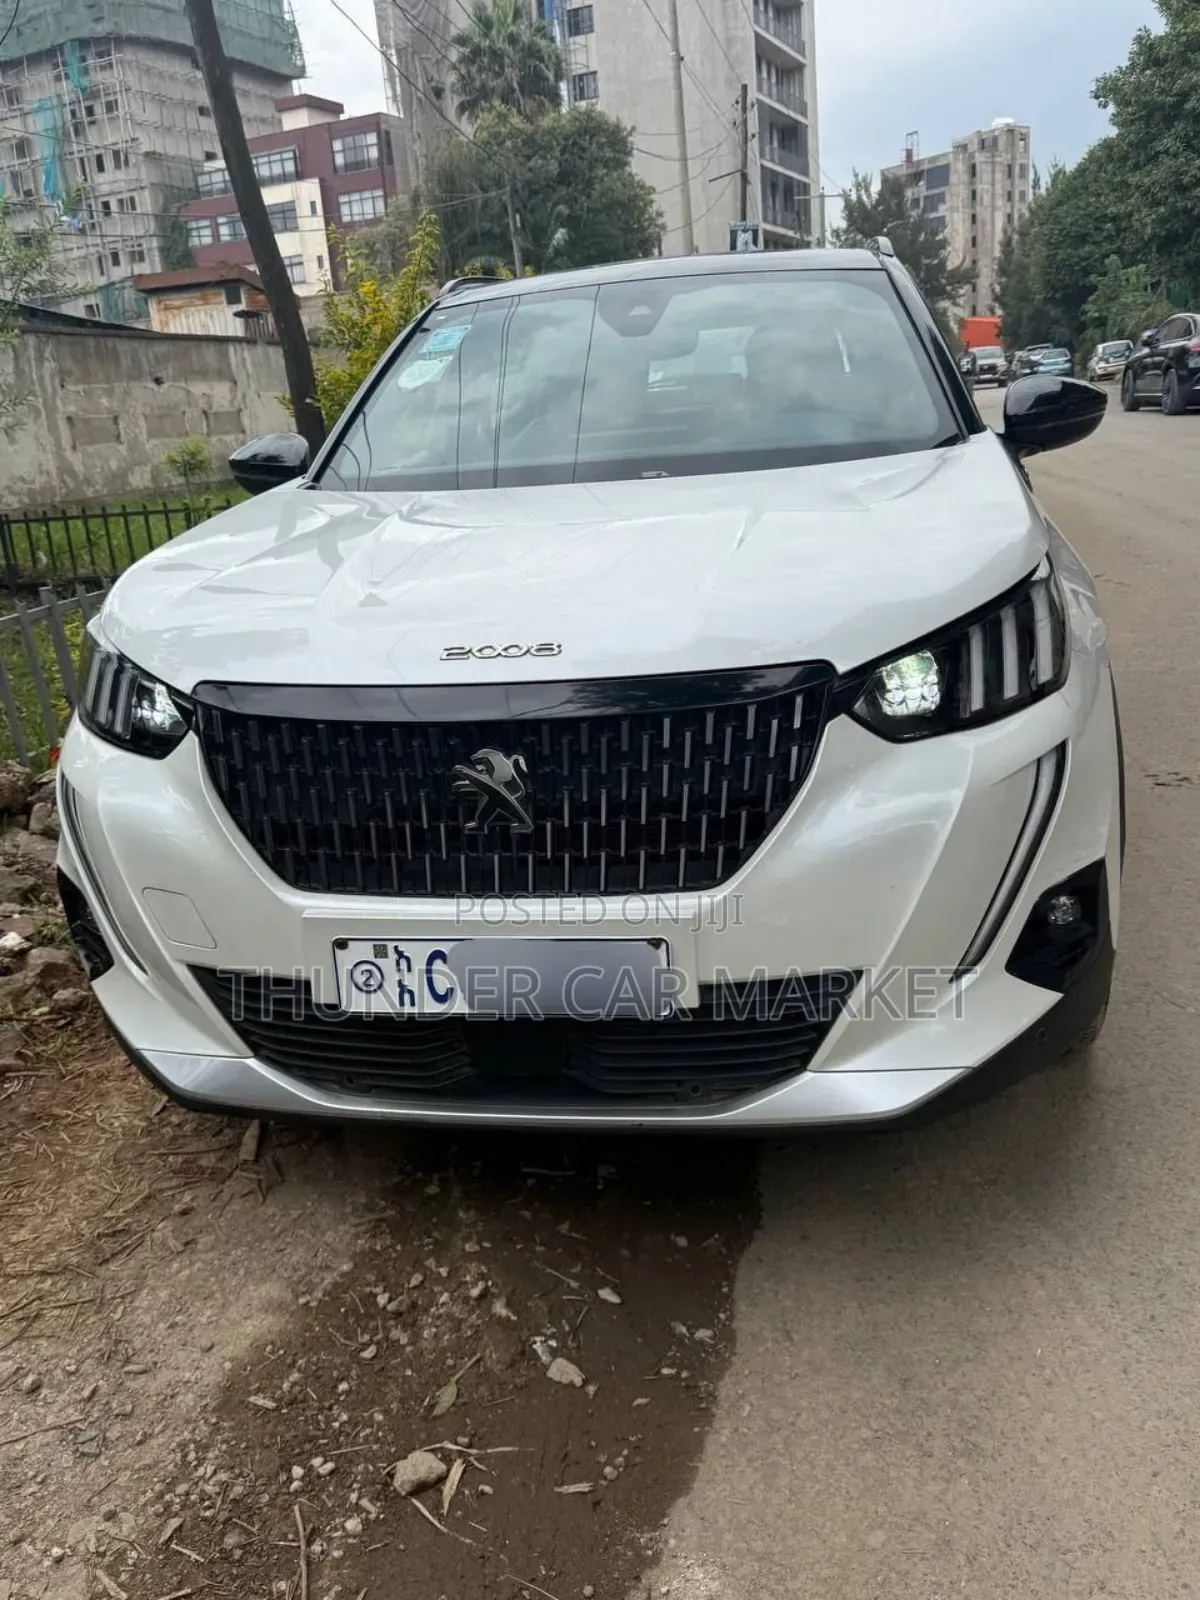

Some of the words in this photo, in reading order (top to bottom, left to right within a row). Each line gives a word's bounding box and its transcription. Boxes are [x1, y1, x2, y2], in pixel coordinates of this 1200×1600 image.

[440, 642, 562, 661] 2008
[360, 968, 374, 988] 2
[426, 949, 455, 1005] C
